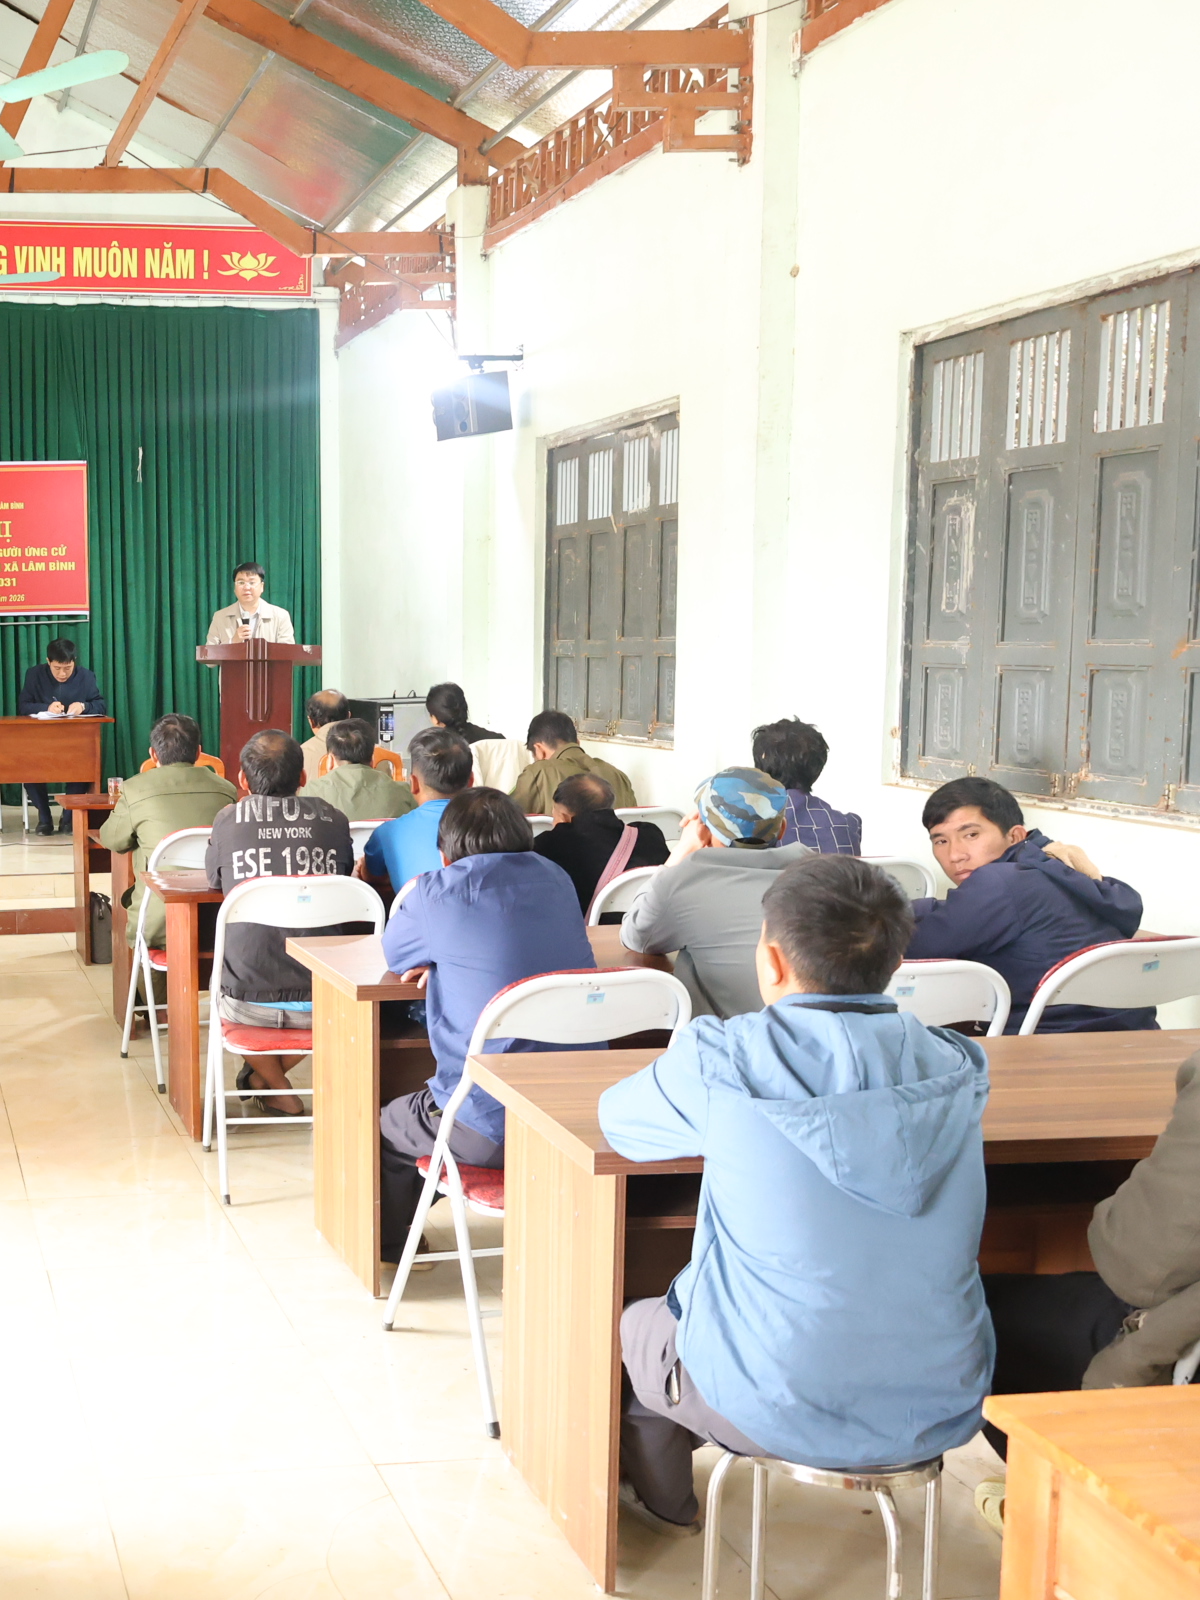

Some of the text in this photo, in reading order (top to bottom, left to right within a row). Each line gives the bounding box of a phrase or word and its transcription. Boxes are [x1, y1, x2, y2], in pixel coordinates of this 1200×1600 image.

[15, 246, 65, 277] VINH
[73, 241, 138, 278] MUÔN
[145, 241, 195, 279] NĂM
[25, 546, 48, 557] ỨNG
[51, 544, 67, 556] CỬ
[4, 561, 19, 572] XÃ
[22, 561, 46, 572] LÂM
[49, 560, 76, 571] BÌNH
[9, 594, 25, 602] 2026
[258, 827, 313, 840] NEW YORK
[232, 846, 337, 879] ESE 1986
